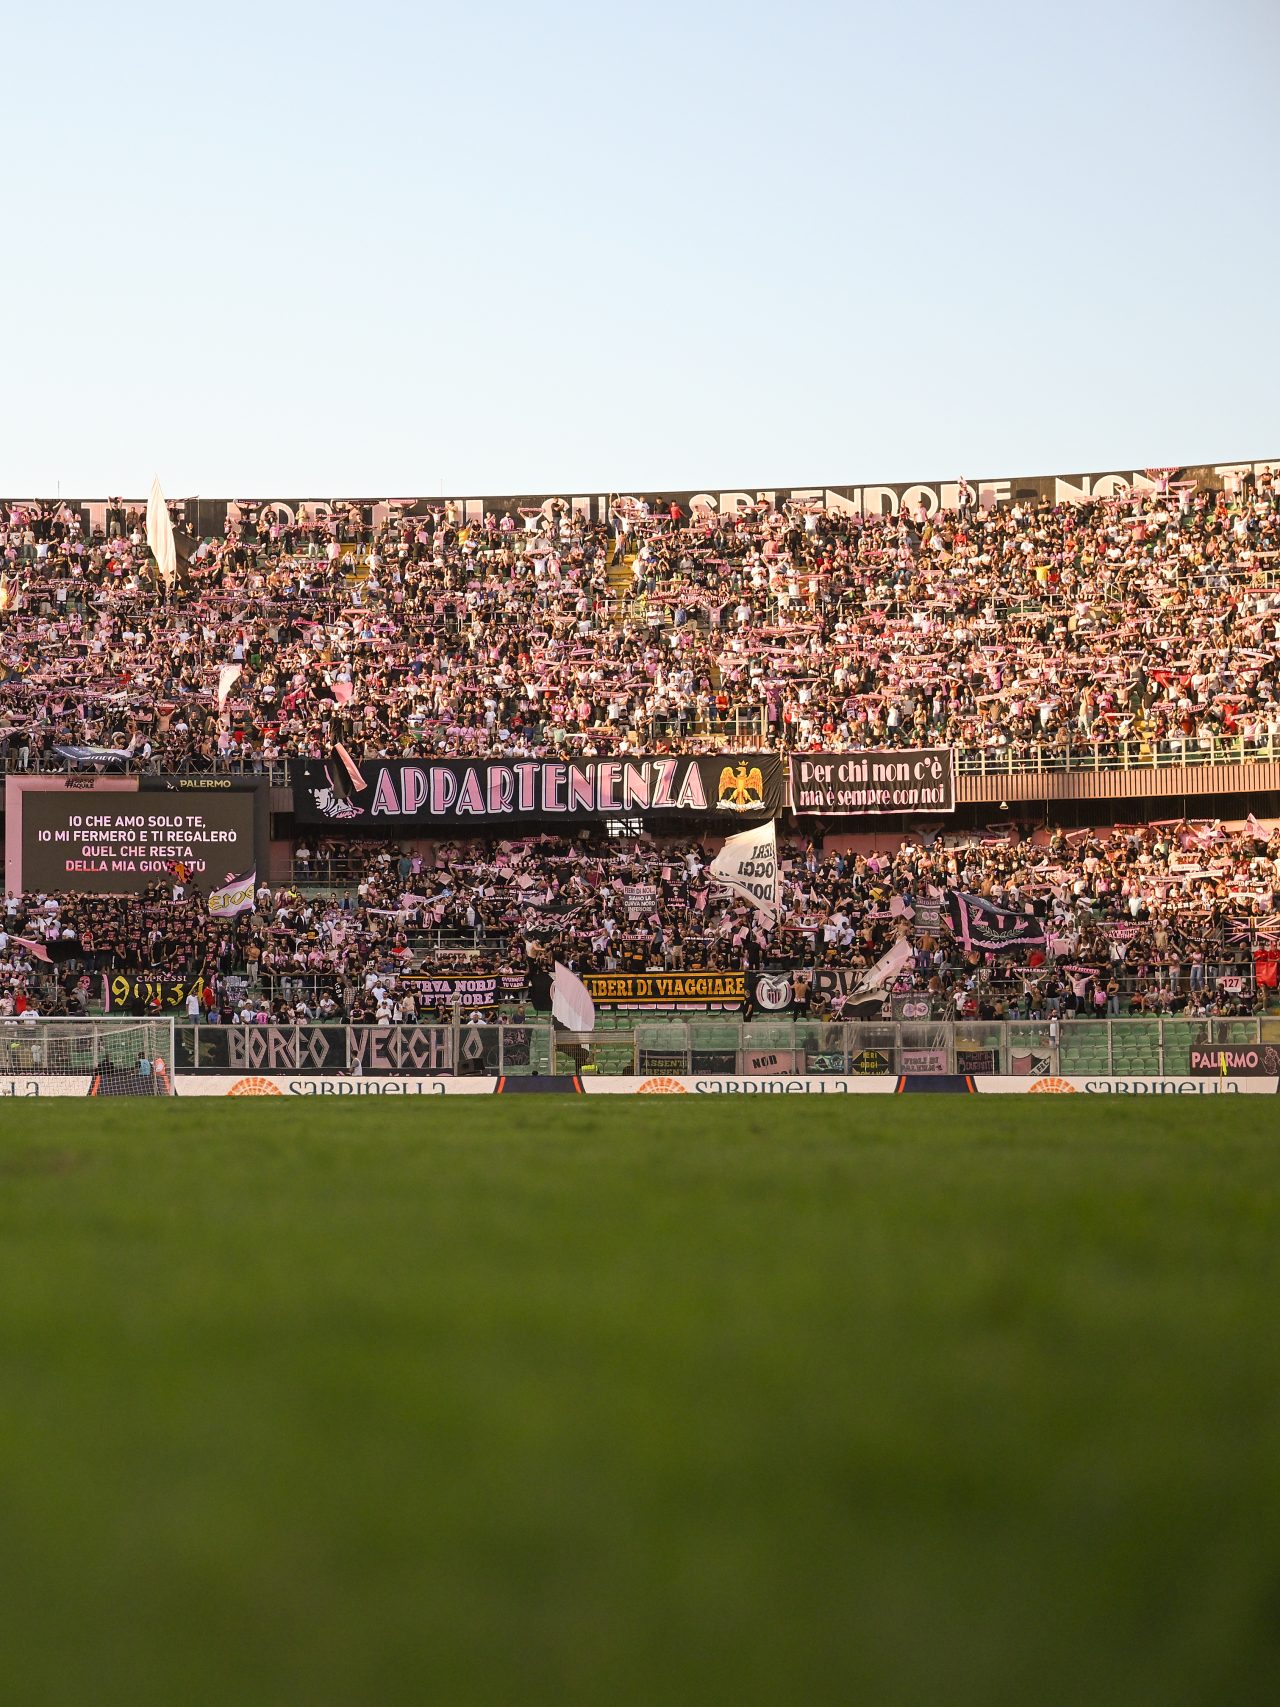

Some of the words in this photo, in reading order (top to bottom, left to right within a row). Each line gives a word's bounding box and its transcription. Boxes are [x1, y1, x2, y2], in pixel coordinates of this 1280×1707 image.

[801, 761, 834, 782] Per
[838, 759, 868, 782] chi
[873, 763, 910, 782] non
[180, 780, 231, 788] PALERMO
[371, 759, 708, 815] APPARTENENZA
[800, 789, 824, 806] ma
[837, 789, 891, 806] sempre
[893, 789, 919, 805] con
[921, 783, 945, 803] noi
[69, 816, 82, 827] IO
[86, 816, 111, 827] CHE
[115, 816, 145, 827] AMO
[148, 816, 182, 827] SOLO
[185, 816, 206, 829] TE,
[38, 830, 52, 842] IO
[54, 830, 69, 842] MI
[73, 828, 135, 842] FERMERÒ
[140, 831, 147, 842] E
[151, 831, 163, 842] TI
[167, 828, 237, 842] REGALERÒ
[82, 846, 116, 858] QUEL
[120, 846, 145, 857] CHE
[150, 846, 193, 857] RESTA
[66, 860, 108, 872] DELLA
[112, 860, 136, 872] MIA
[454, 979, 496, 992] NORD
[583, 979, 633, 997] LIBERI
[636, 979, 653, 996] DI
[655, 977, 745, 996] VIAGGIARE
[1223, 979, 1239, 988] 127
[1191, 1051, 1259, 1069] PALERMO
